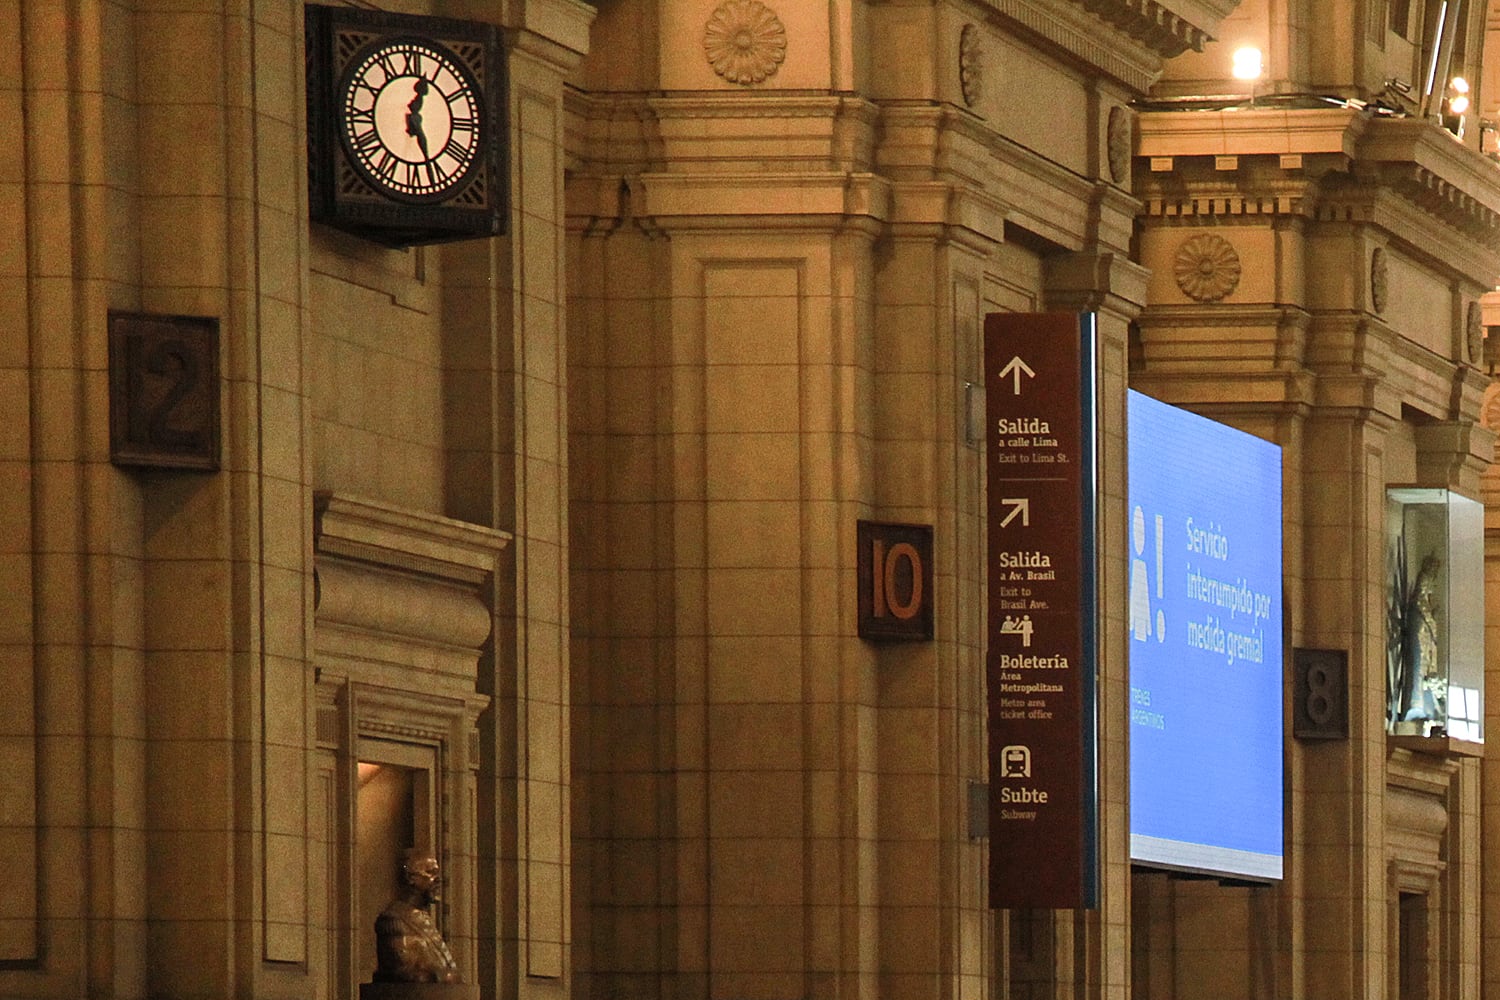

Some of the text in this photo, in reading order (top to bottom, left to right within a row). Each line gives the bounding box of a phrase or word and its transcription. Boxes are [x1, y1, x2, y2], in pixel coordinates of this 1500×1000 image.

[998, 418, 1050, 434] Salida
[999, 437, 1058, 447] a calle Lima
[999, 453, 1069, 463] Exit to Lima St.
[1187, 517, 1228, 561] Servicio
[999, 552, 1051, 568] Salida
[873, 539, 923, 619] 10
[1009, 572, 1024, 580] Av.
[1027, 571, 1055, 580] Brasil
[1000, 587, 1031, 596] Exit to
[1187, 563, 1271, 626] interrumpido por
[1001, 599, 1049, 609] Brasil Ave.
[1188, 615, 1263, 666] medida gremial
[1000, 654, 1069, 669] Boletería
[1000, 669, 1022, 680] Área
[1000, 683, 1064, 694] Metropolitana
[1307, 663, 1333, 725] 8
[1001, 698, 1025, 707] Metro
[1028, 709, 1053, 719] office
[1001, 787, 1048, 804] Subte
[1001, 810, 1037, 820] Subway
